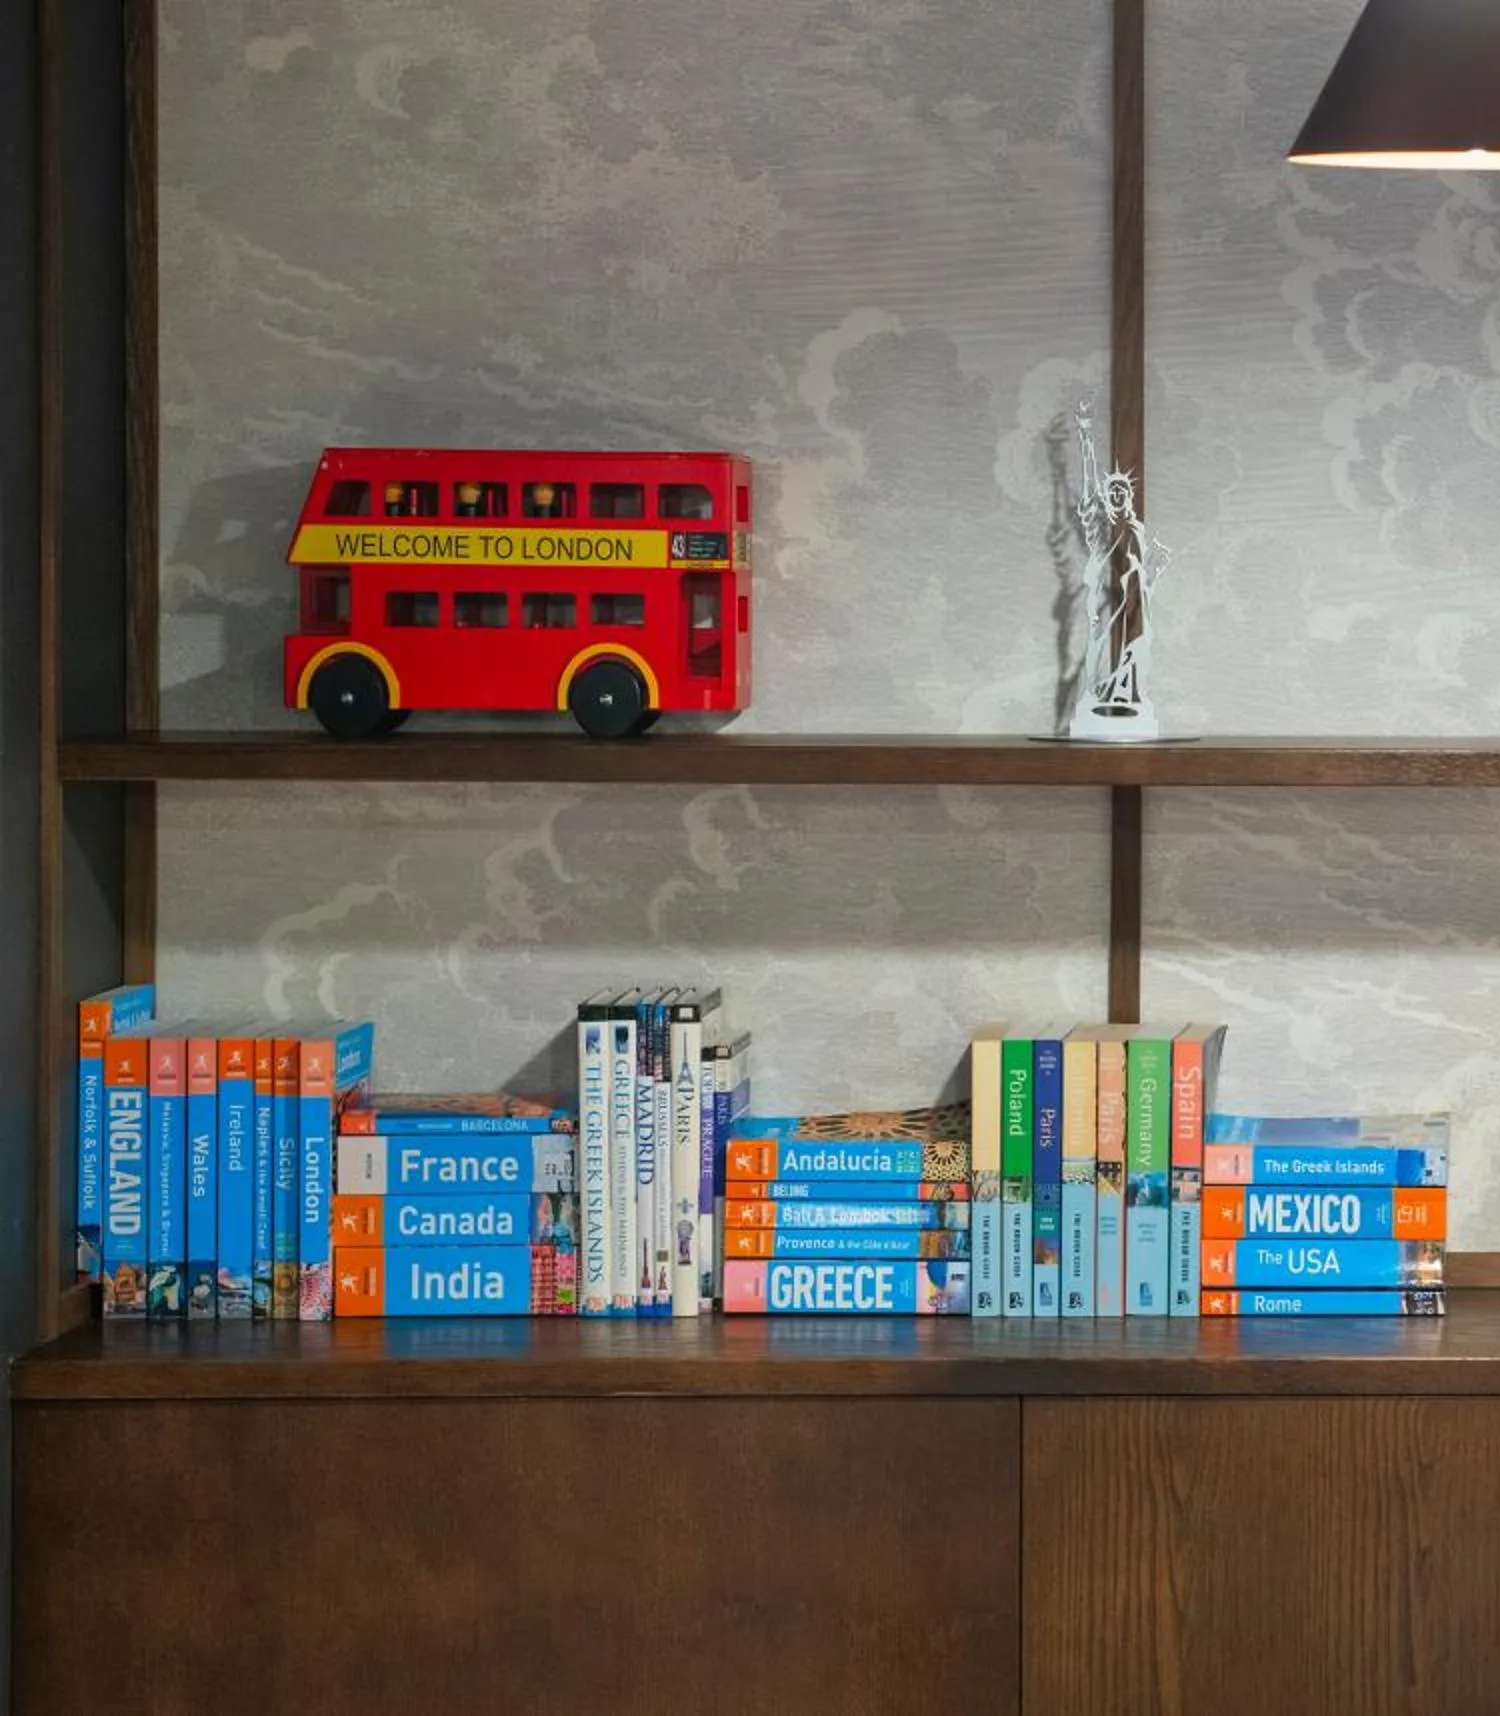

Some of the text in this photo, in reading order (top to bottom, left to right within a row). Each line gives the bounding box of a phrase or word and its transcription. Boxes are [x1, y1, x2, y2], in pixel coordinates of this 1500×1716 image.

[336, 533, 633, 562] WELCOME TO LONDON
[461, 1119, 529, 1133] BARCELONA
[614, 1060, 630, 1139] GREECE
[658, 1090, 668, 1147] BRUSSELS
[1009, 1069, 1028, 1137] Poland
[1100, 1090, 1119, 1144] Paris
[1136, 1077, 1157, 1167] Germany
[1174, 1066, 1201, 1140] Spain
[83, 1075, 97, 1209] Norfolk & Suffolk
[229, 1104, 245, 1171] Ireland
[256, 1107, 270, 1156] Naples
[637, 1084, 655, 1185] MADRID
[702, 1118, 713, 1179] PRAGUE
[1039, 1108, 1056, 1148] Paris
[109, 1091, 142, 1235] ENGLAND
[193, 1135, 209, 1198] Wales
[275, 1137, 294, 1190] Sicily
[304, 1137, 324, 1223] London
[401, 1149, 519, 1183] France
[584, 1060, 604, 1283] THE GREEK ISLANDS
[1263, 1159, 1385, 1174] The Greek Islands
[399, 1205, 513, 1236] Canada
[1249, 1194, 1361, 1233] MEXICO
[777, 1236, 835, 1249] Provence
[1256, 1247, 1341, 1274] The USA
[411, 1263, 505, 1299] India
[771, 1265, 895, 1309] GREECE
[1254, 1296, 1302, 1313] Rome
